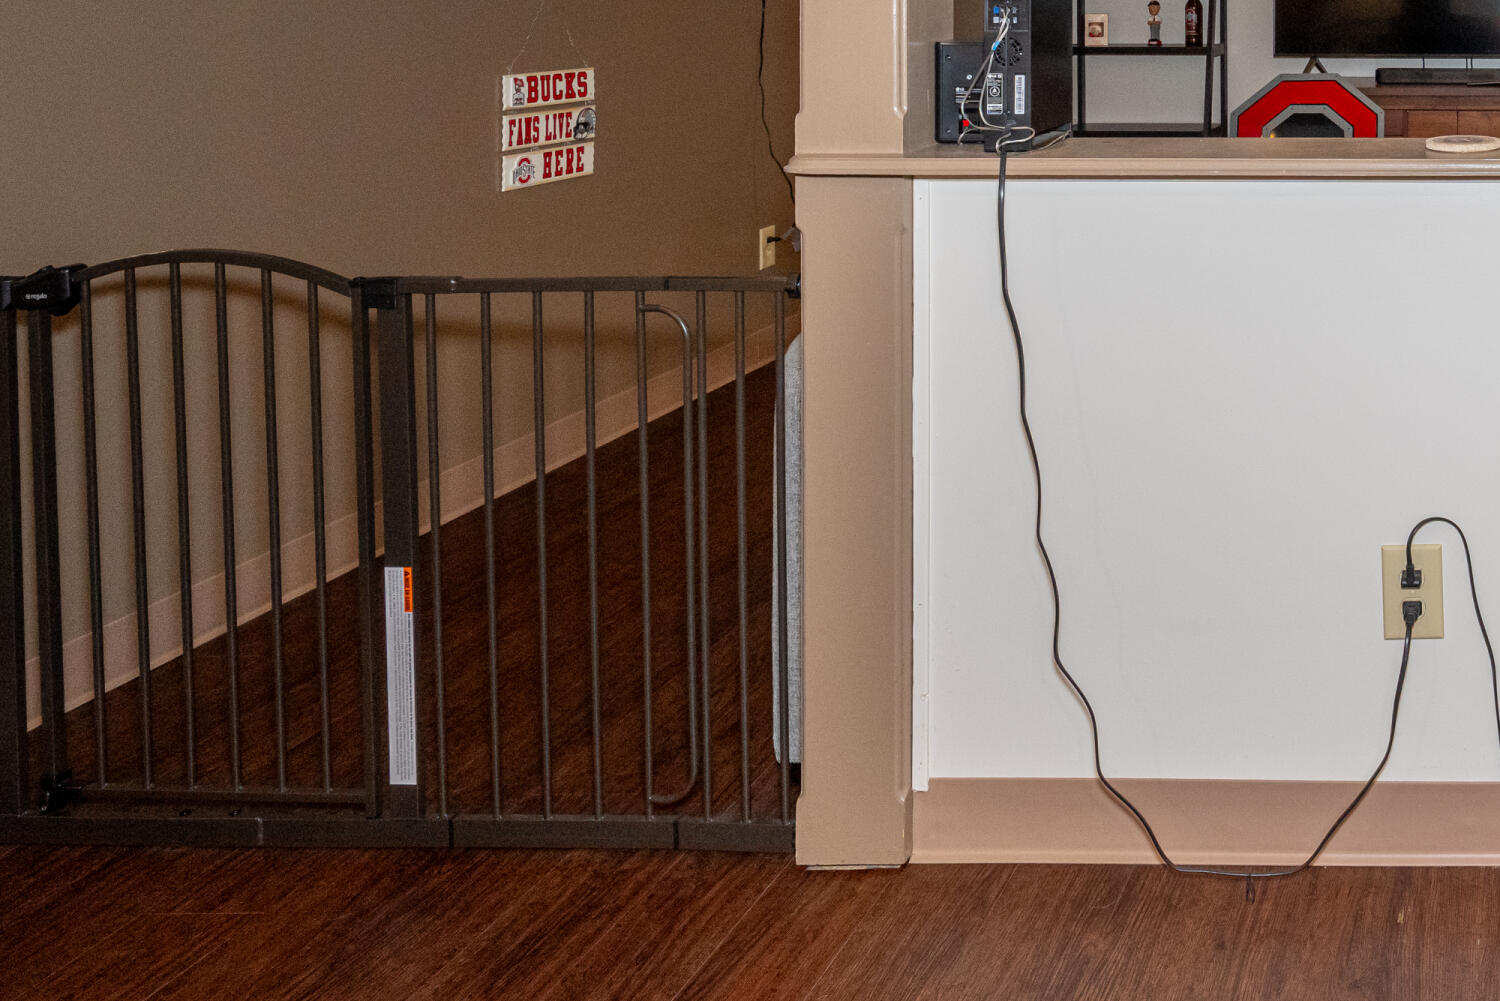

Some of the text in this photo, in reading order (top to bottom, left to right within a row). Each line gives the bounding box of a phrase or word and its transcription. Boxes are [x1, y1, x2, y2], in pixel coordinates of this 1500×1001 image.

[526, 71, 588, 104] BUCKS
[508, 111, 573, 147] FANS LIVE
[542, 145, 585, 179] HERE
